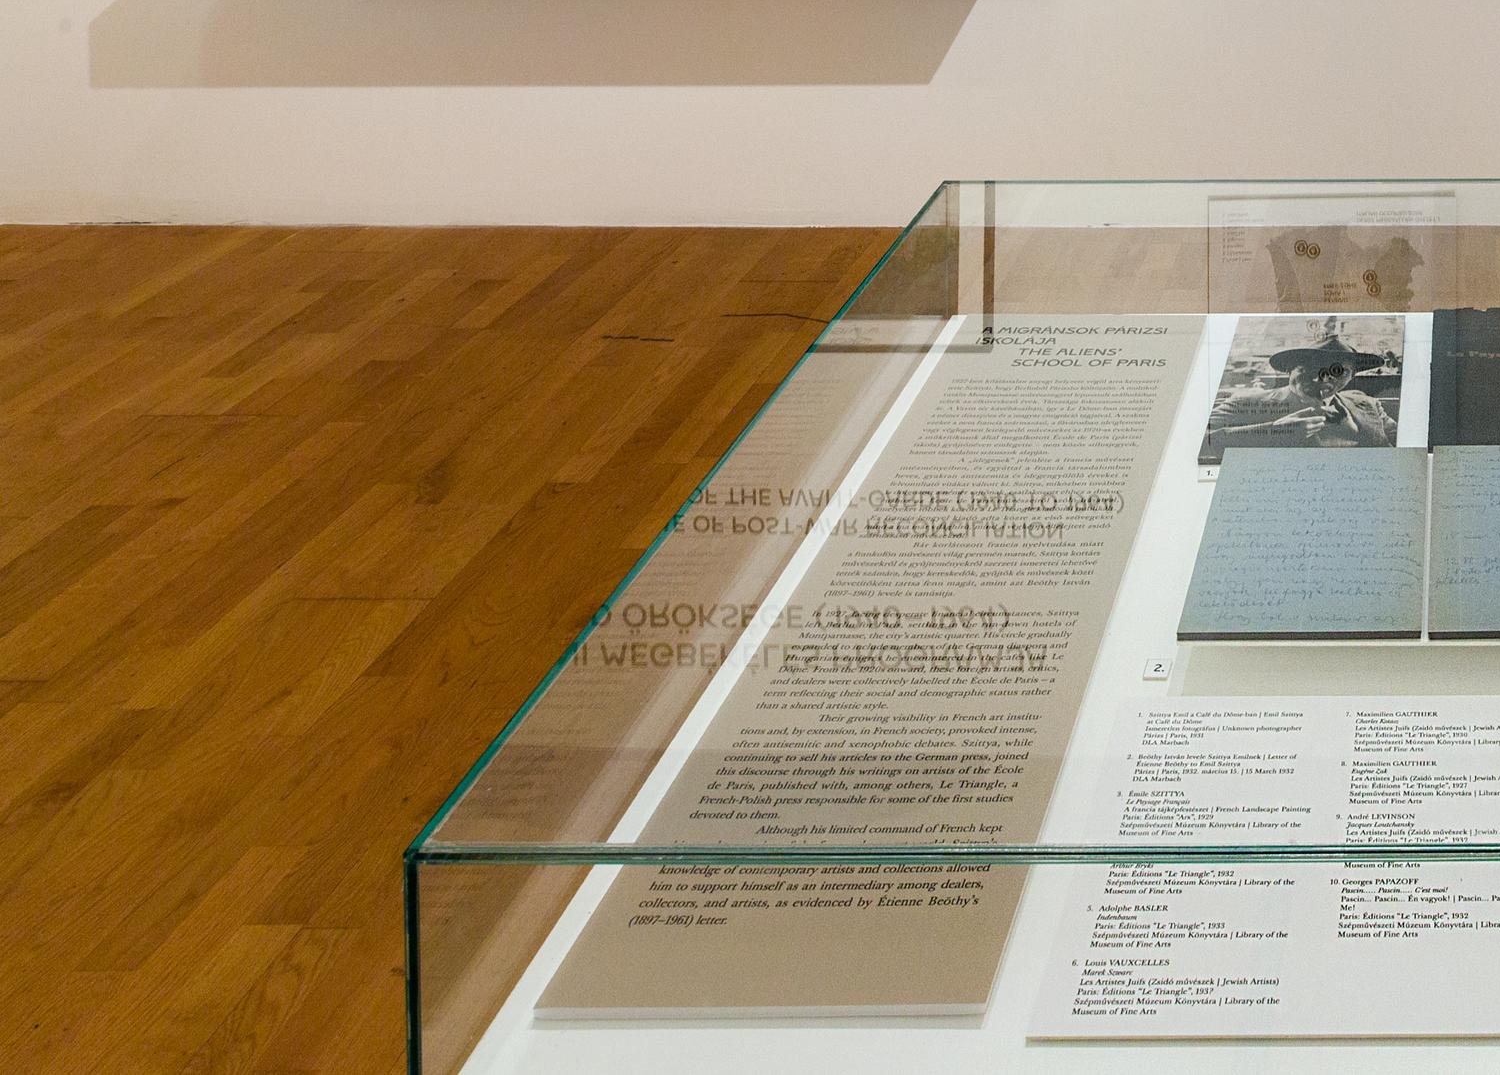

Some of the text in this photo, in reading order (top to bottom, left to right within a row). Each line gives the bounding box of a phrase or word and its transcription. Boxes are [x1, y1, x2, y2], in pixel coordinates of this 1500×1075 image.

[997, 325, 1099, 335] MIGRÁNSOK
[1104, 325, 1169, 335] PÁRIZSI
[975, 336, 1057, 345] ISKOLÁJA
[1019, 348, 1051, 356] THE
[1011, 359, 1167, 367] SCHOOL OF PARIS
[1154, 663, 1165, 673] 2.
[639, 897, 699, 909] collectors,
[704, 897, 727, 908] and
[731, 896, 769, 909] artists,
[776, 899, 788, 908] as
[792, 896, 852, 908] evidenced
[857, 896, 874, 910] by
[877, 894, 924, 907] Étienne
[1098, 905, 1132, 914] Adolphe
[694, 915, 728, 926] letter.
[1084, 959, 1170, 967] Louis VAUXCELLES
